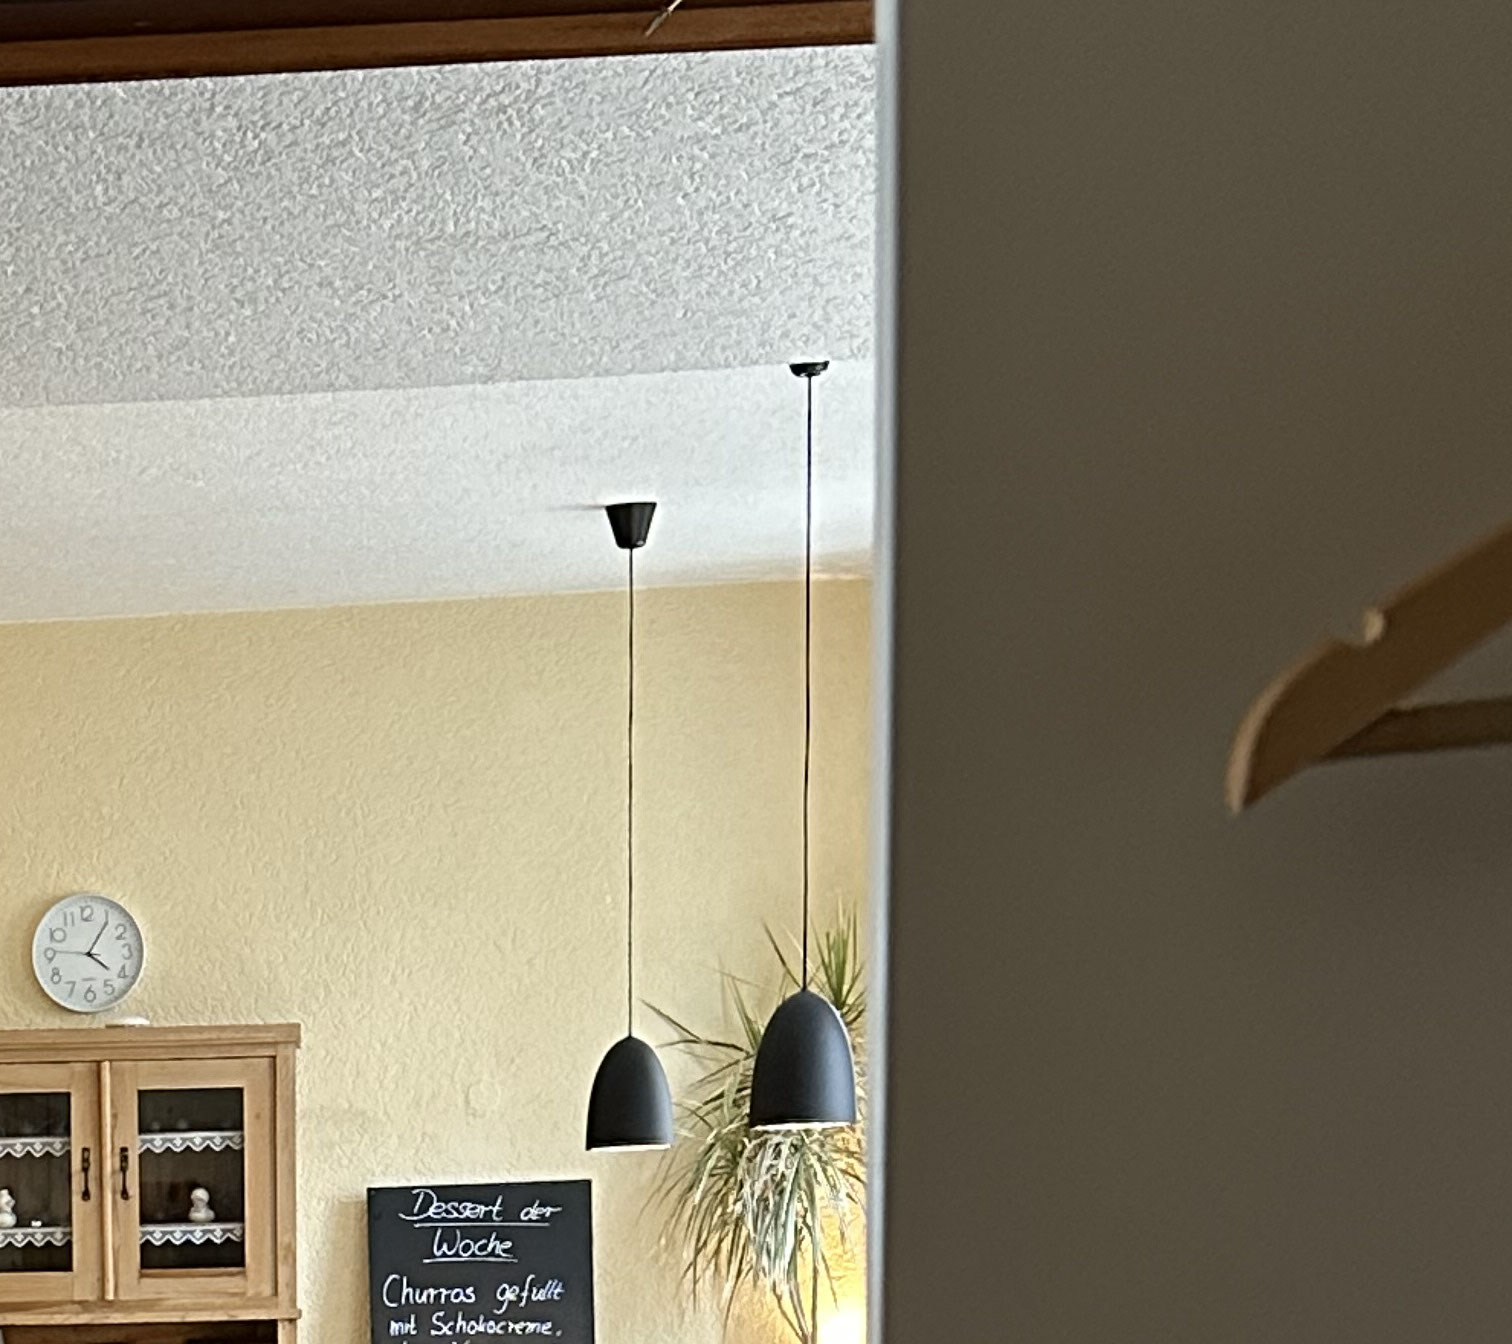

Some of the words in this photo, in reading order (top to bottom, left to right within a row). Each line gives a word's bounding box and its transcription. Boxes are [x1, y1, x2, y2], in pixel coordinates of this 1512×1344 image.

[63, 911, 76, 927] 11
[79, 905, 94, 922] 12
[49, 927, 67, 943] 10
[114, 923, 127, 940] 2
[44, 947, 56, 964] 9
[121, 943, 133, 960] 3
[50, 967, 62, 985] 8
[117, 963, 128, 979] 4
[64, 981, 76, 998] 7
[84, 985, 96, 1003] 6
[103, 980, 115, 995] 5
[398, 1188, 503, 1221] Dessert
[520, 1199, 563, 1221] der
[433, 1228, 513, 1258] Woche
[390, 1313, 418, 1337] mit
